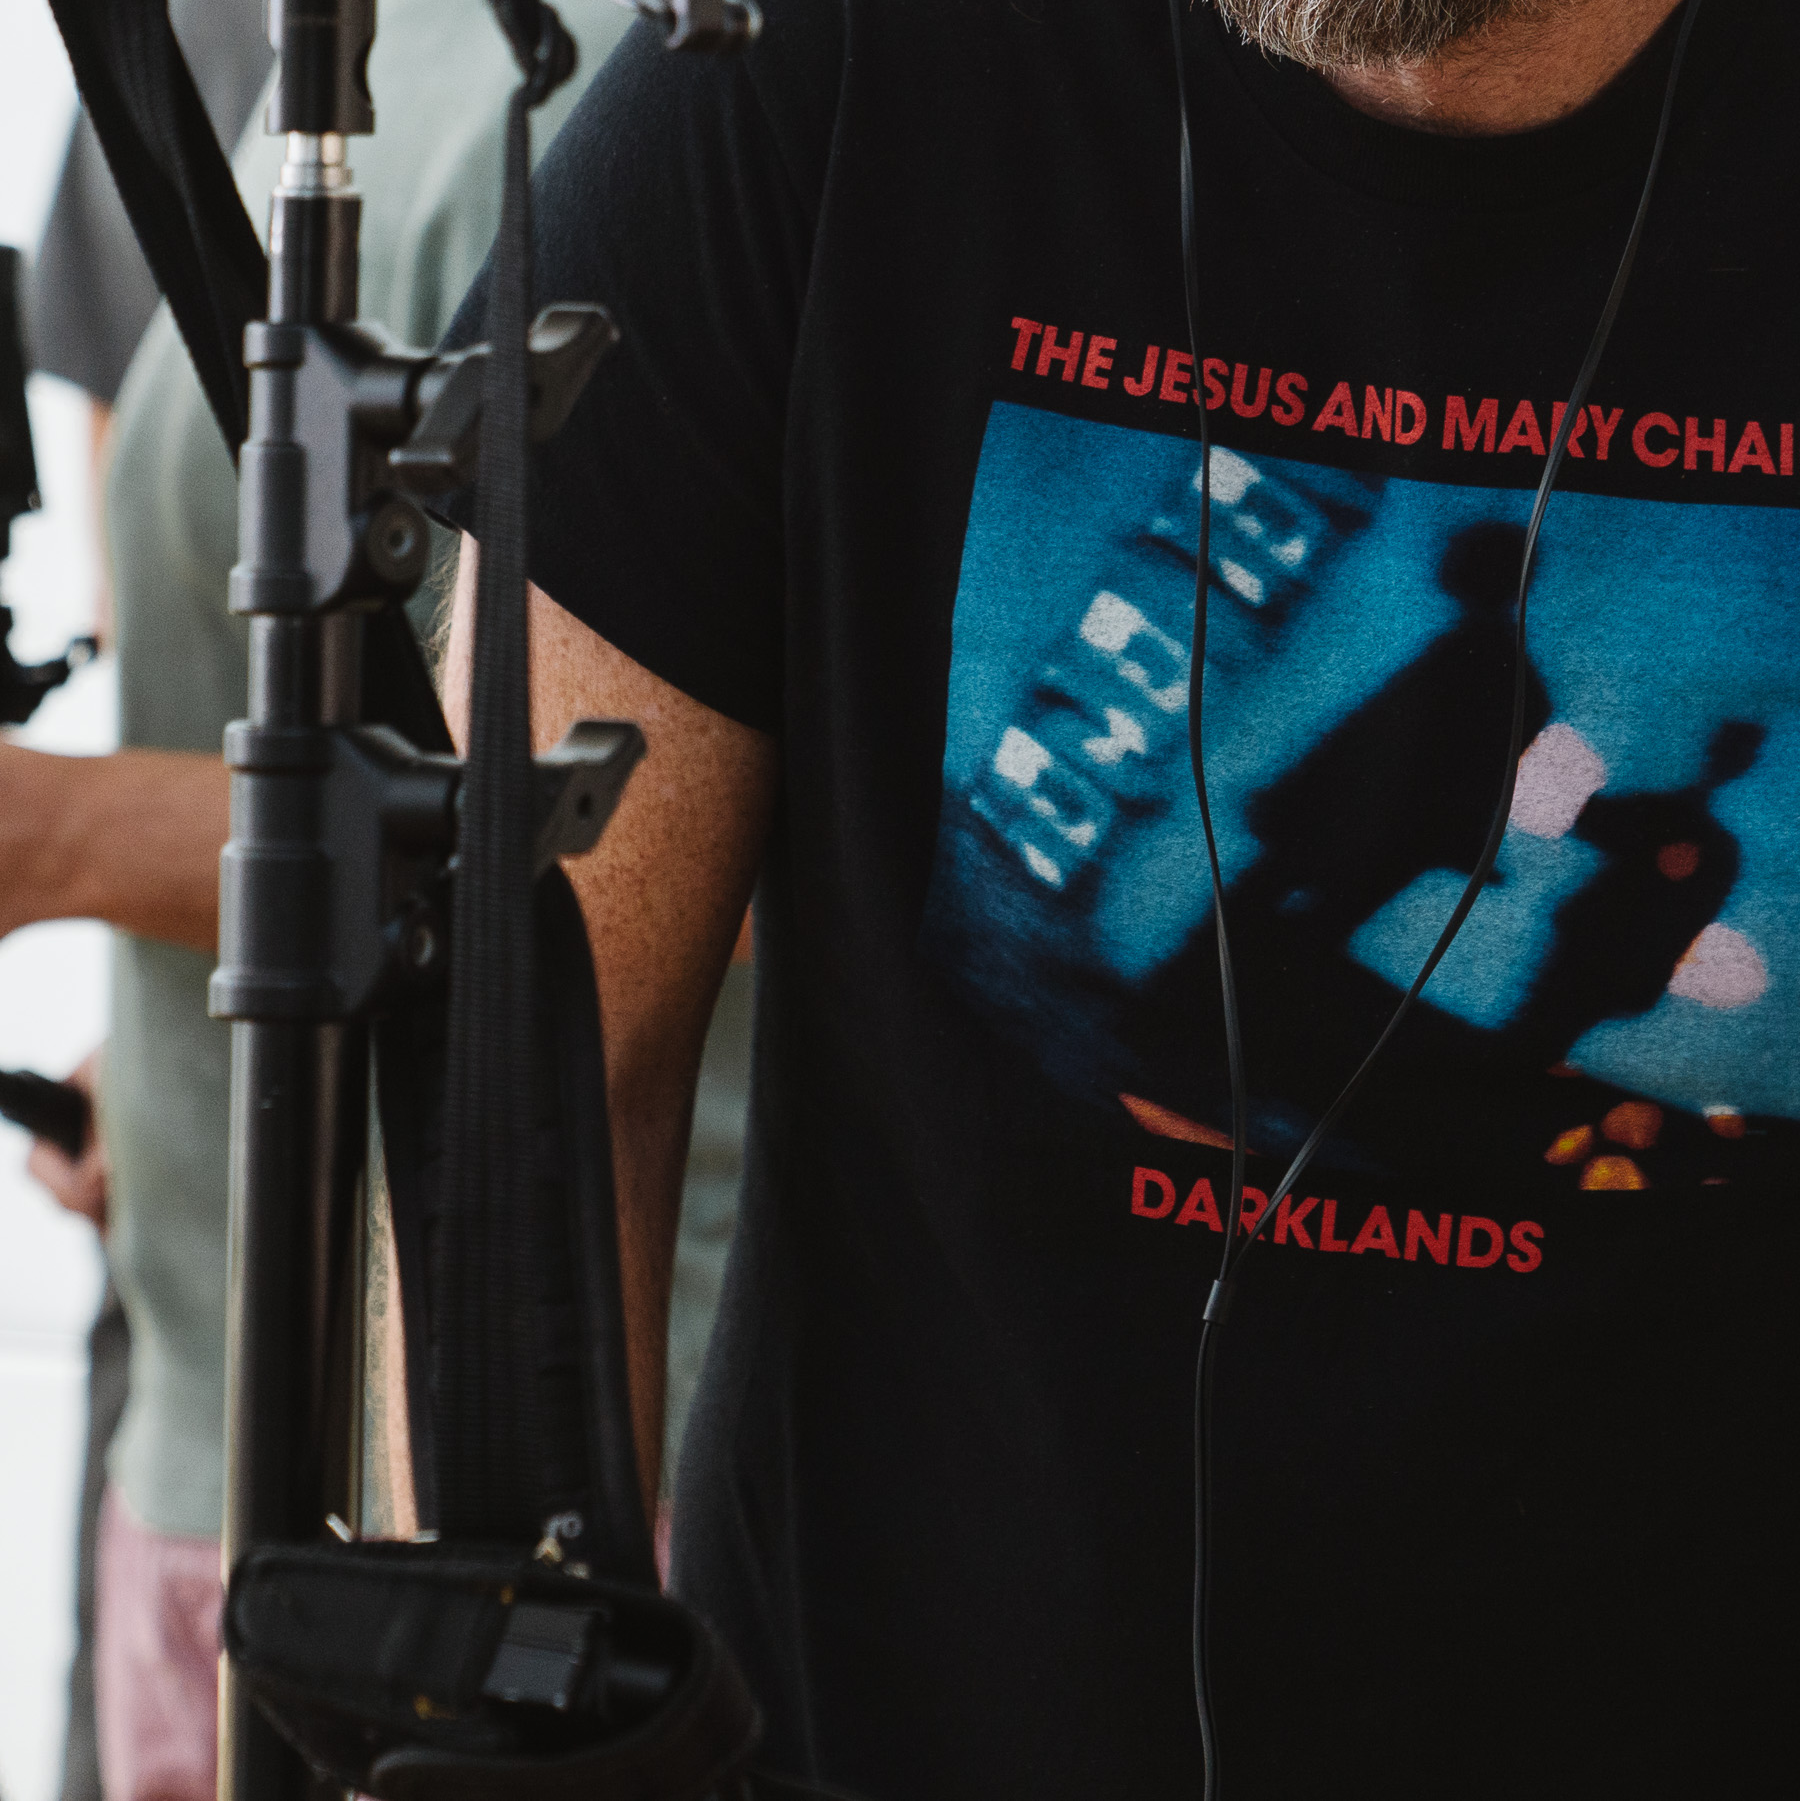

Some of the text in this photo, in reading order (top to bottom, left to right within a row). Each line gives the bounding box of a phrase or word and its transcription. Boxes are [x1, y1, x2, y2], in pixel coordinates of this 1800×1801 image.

[1010, 316, 1118, 390] THE
[1123, 344, 1309, 427] JESUS
[1311, 381, 1428, 446] AND
[1442, 395, 1625, 461] MARY
[1131, 1166, 1545, 1273] DARKLANDS
